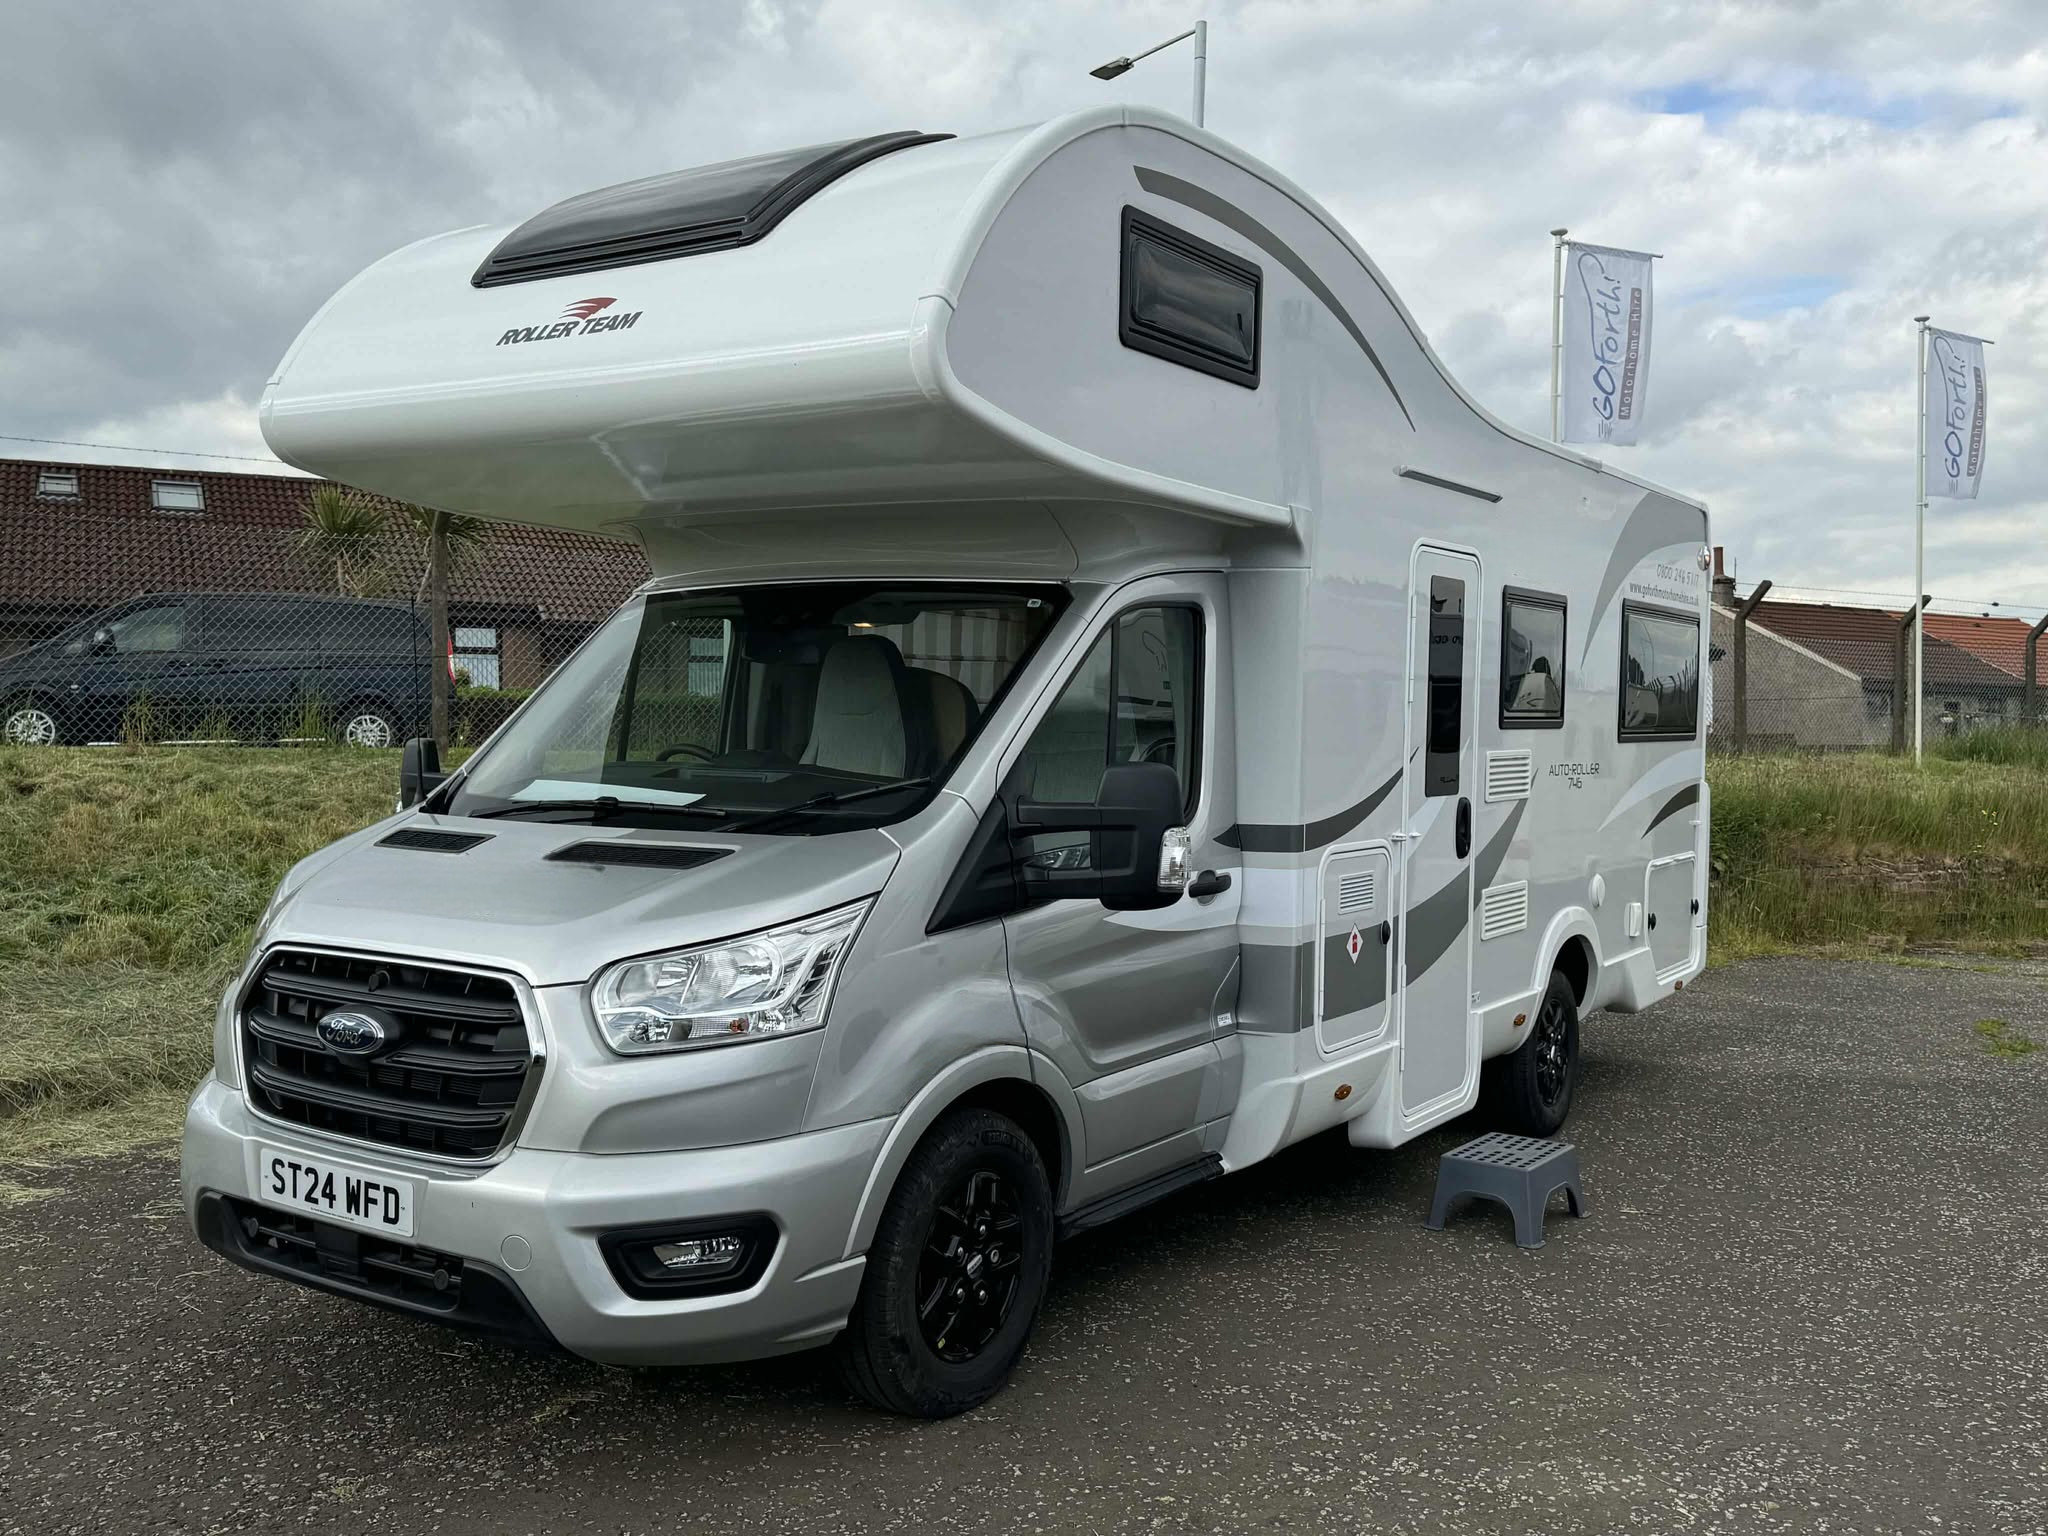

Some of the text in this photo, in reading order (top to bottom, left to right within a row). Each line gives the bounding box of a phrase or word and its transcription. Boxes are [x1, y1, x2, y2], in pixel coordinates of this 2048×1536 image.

[495, 311, 643, 346] ROLLER TEAM
[1620, 290, 1642, 416] Motorhome Hire
[1656, 564, 1673, 580] 0800
[1674, 568, 1685, 584] 246
[1548, 763, 1600, 776] AUTO-ROLLER
[1567, 777, 1582, 790] 746
[326, 1018, 364, 1045] Ford
[271, 1158, 400, 1225] ST24 WFD
